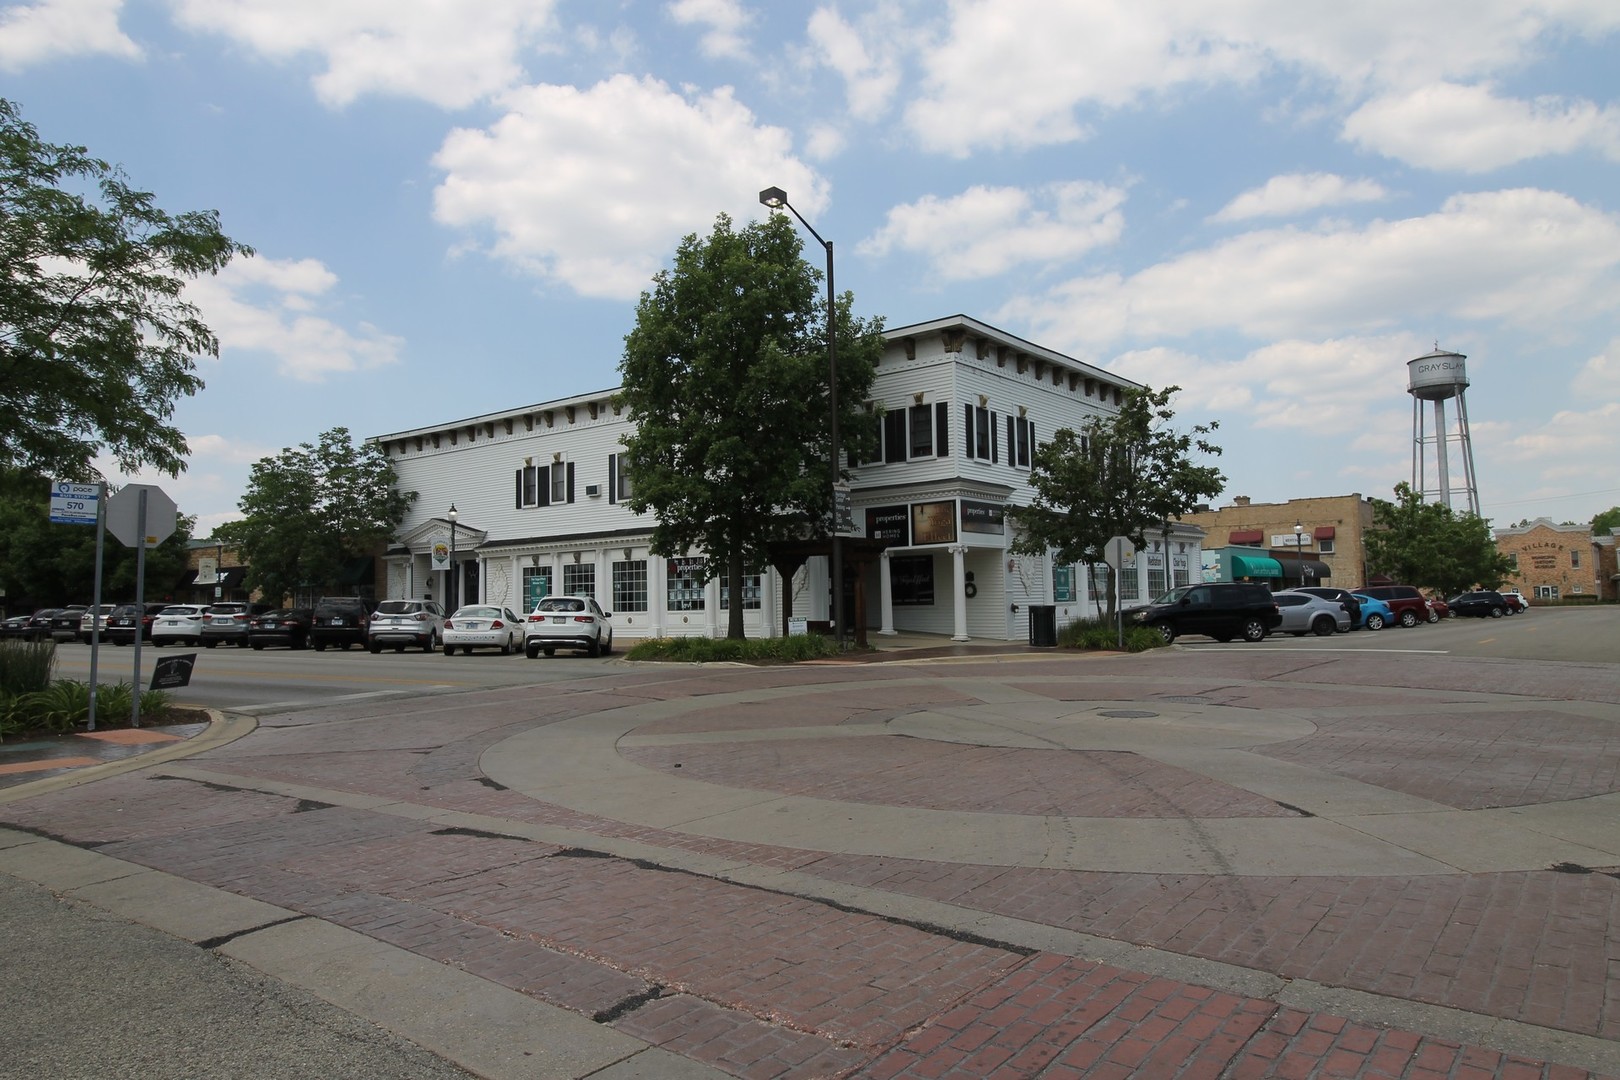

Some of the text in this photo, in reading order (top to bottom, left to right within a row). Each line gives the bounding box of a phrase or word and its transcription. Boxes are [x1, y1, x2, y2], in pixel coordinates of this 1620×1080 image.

[67, 502, 84, 510] 570
[876, 513, 907, 524] properties
[1521, 542, 1564, 552] VILLAGE
